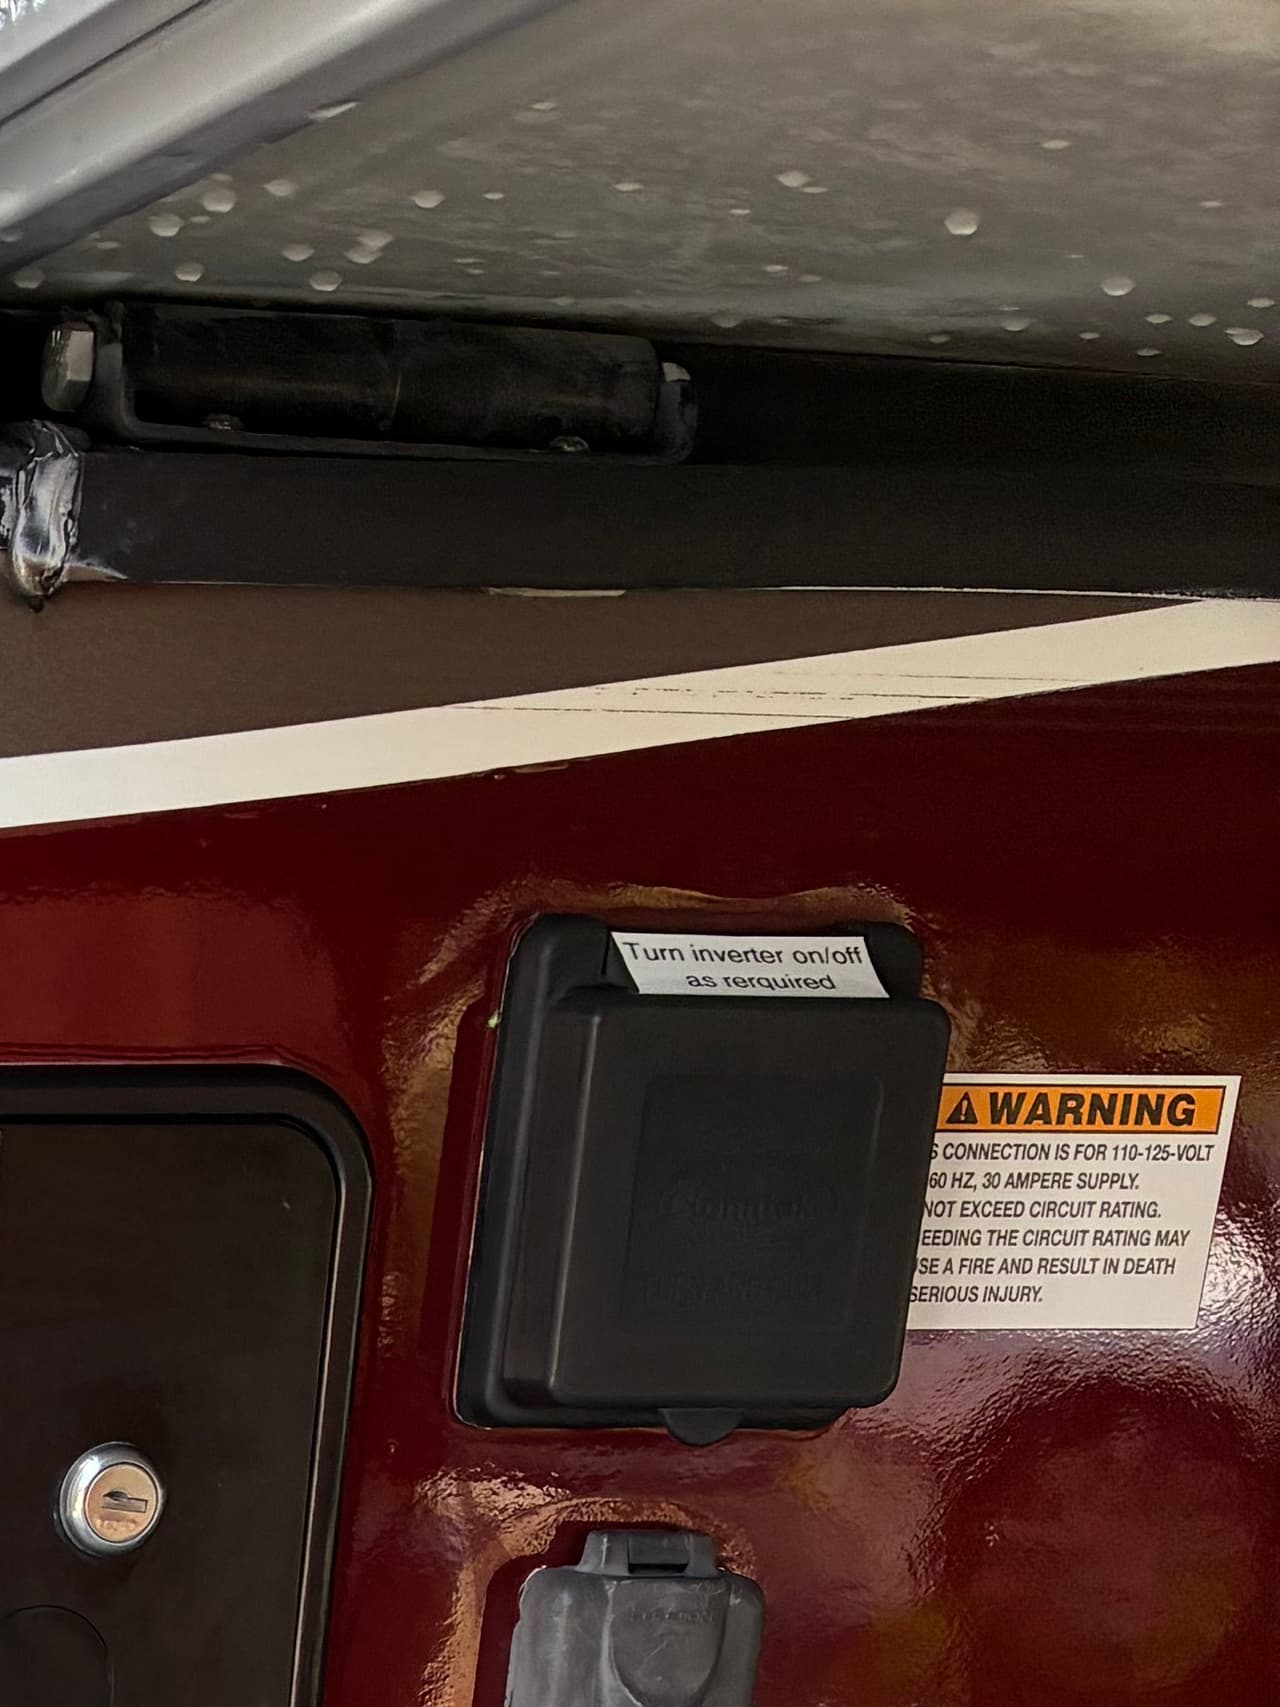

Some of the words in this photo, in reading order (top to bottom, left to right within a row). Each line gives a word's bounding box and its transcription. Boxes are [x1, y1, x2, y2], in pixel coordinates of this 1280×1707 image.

[622, 942, 685, 961] Turn
[690, 944, 783, 964] inverter
[792, 946, 862, 965] on/off
[686, 975, 718, 988] as
[723, 974, 836, 991] rerquired
[989, 1091, 1196, 1127] WARNING
[942, 1142, 1051, 1160] CONNECTION
[1054, 1143, 1070, 1161] IS
[1073, 1144, 1107, 1161] FOR
[1112, 1144, 1215, 1161] 110-125-VOLT
[929, 1172, 947, 1189] 60
[951, 1172, 977, 1192] HZ,
[982, 1172, 1001, 1189] 30
[1004, 1172, 1074, 1189] AMPERE
[1076, 1172, 1139, 1190] SUPPLY.
[923, 1201, 956, 1218] NOT
[959, 1200, 1025, 1218] EXCEED
[1029, 1201, 1097, 1218] CIRCUIT
[1099, 1201, 1161, 1218] RATING.
[987, 1229, 1020, 1246] THE
[1022, 1229, 1090, 1247] CIRCUIT
[1092, 1229, 1151, 1247] RATING
[1154, 1230, 1191, 1247] MAY
[942, 1257, 954, 1275] A
[958, 1258, 995, 1275] FIRE
[997, 1258, 1033, 1275] AND
[1037, 1257, 1100, 1275] RESULT
[1102, 1258, 1120, 1275] IN
[1123, 1258, 1176, 1275] DEATH
[909, 1286, 979, 1303] SERIOUS
[982, 1286, 1042, 1303] INJURY.
